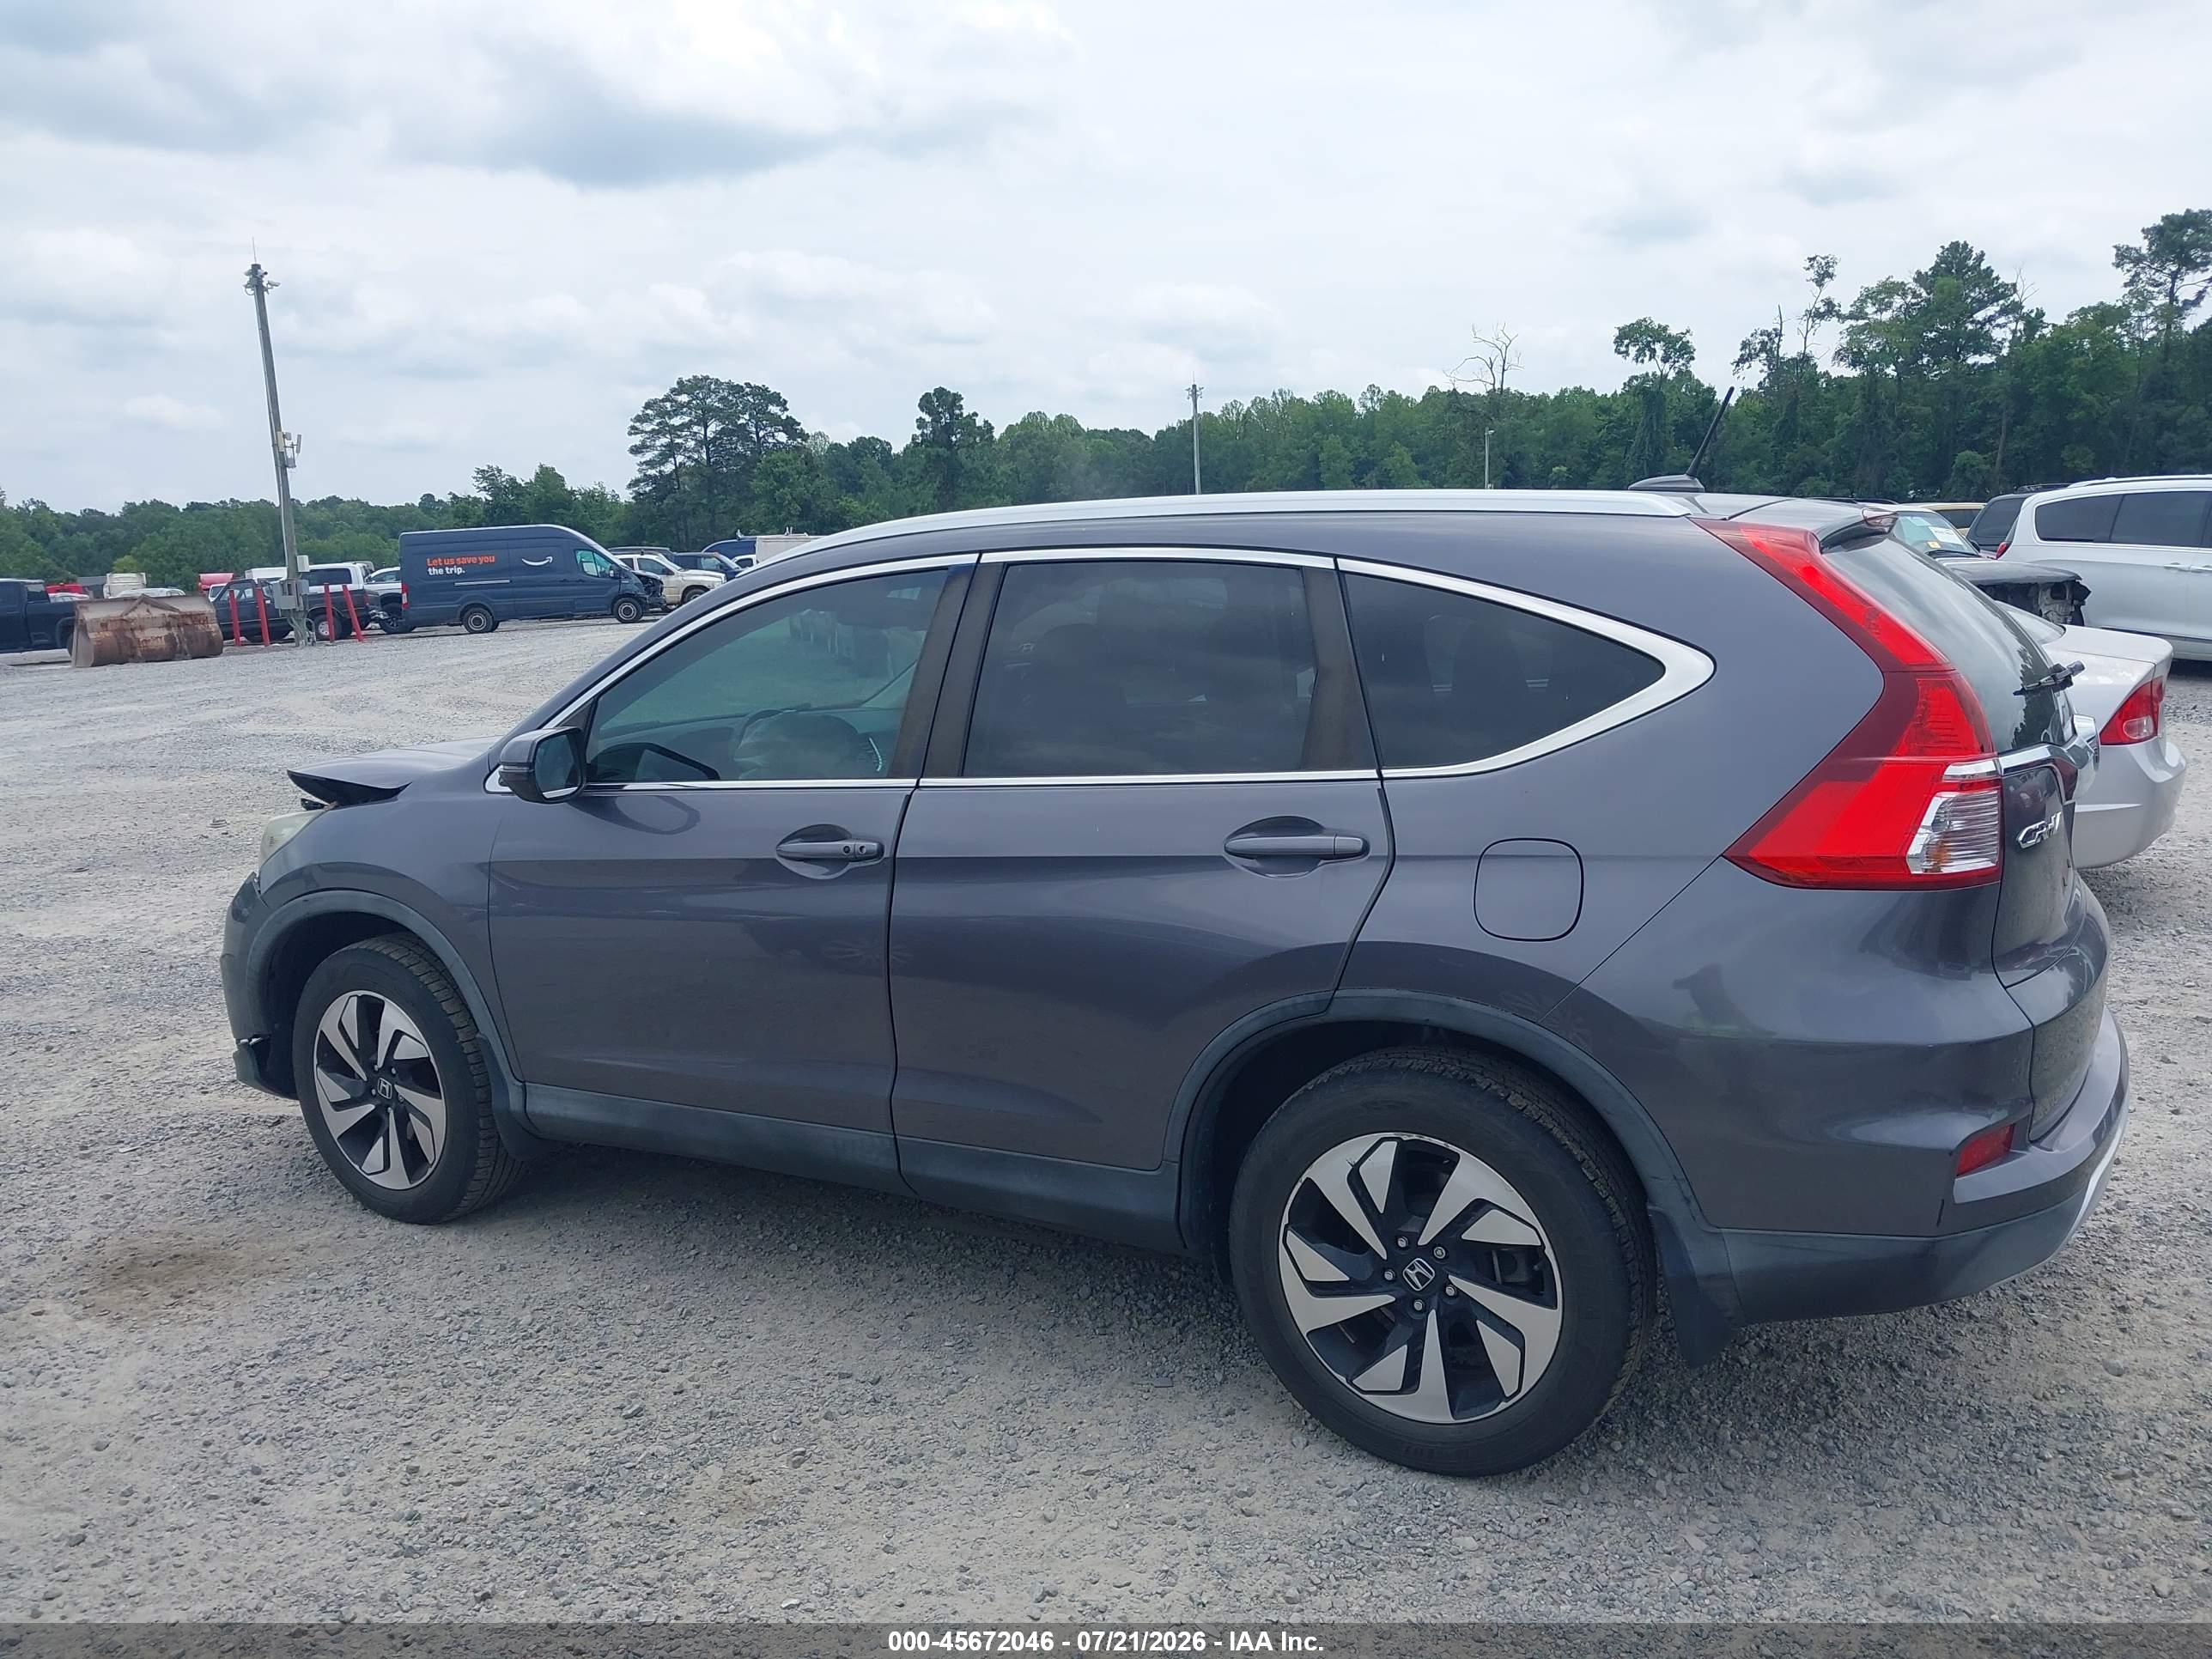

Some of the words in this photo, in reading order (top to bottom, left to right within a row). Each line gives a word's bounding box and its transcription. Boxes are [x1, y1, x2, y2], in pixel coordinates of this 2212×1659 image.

[427, 557, 442, 566] Let
[456, 556, 477, 565] save
[478, 556, 495, 564] you
[428, 567, 444, 575] the
[445, 565, 465, 575] trip.
